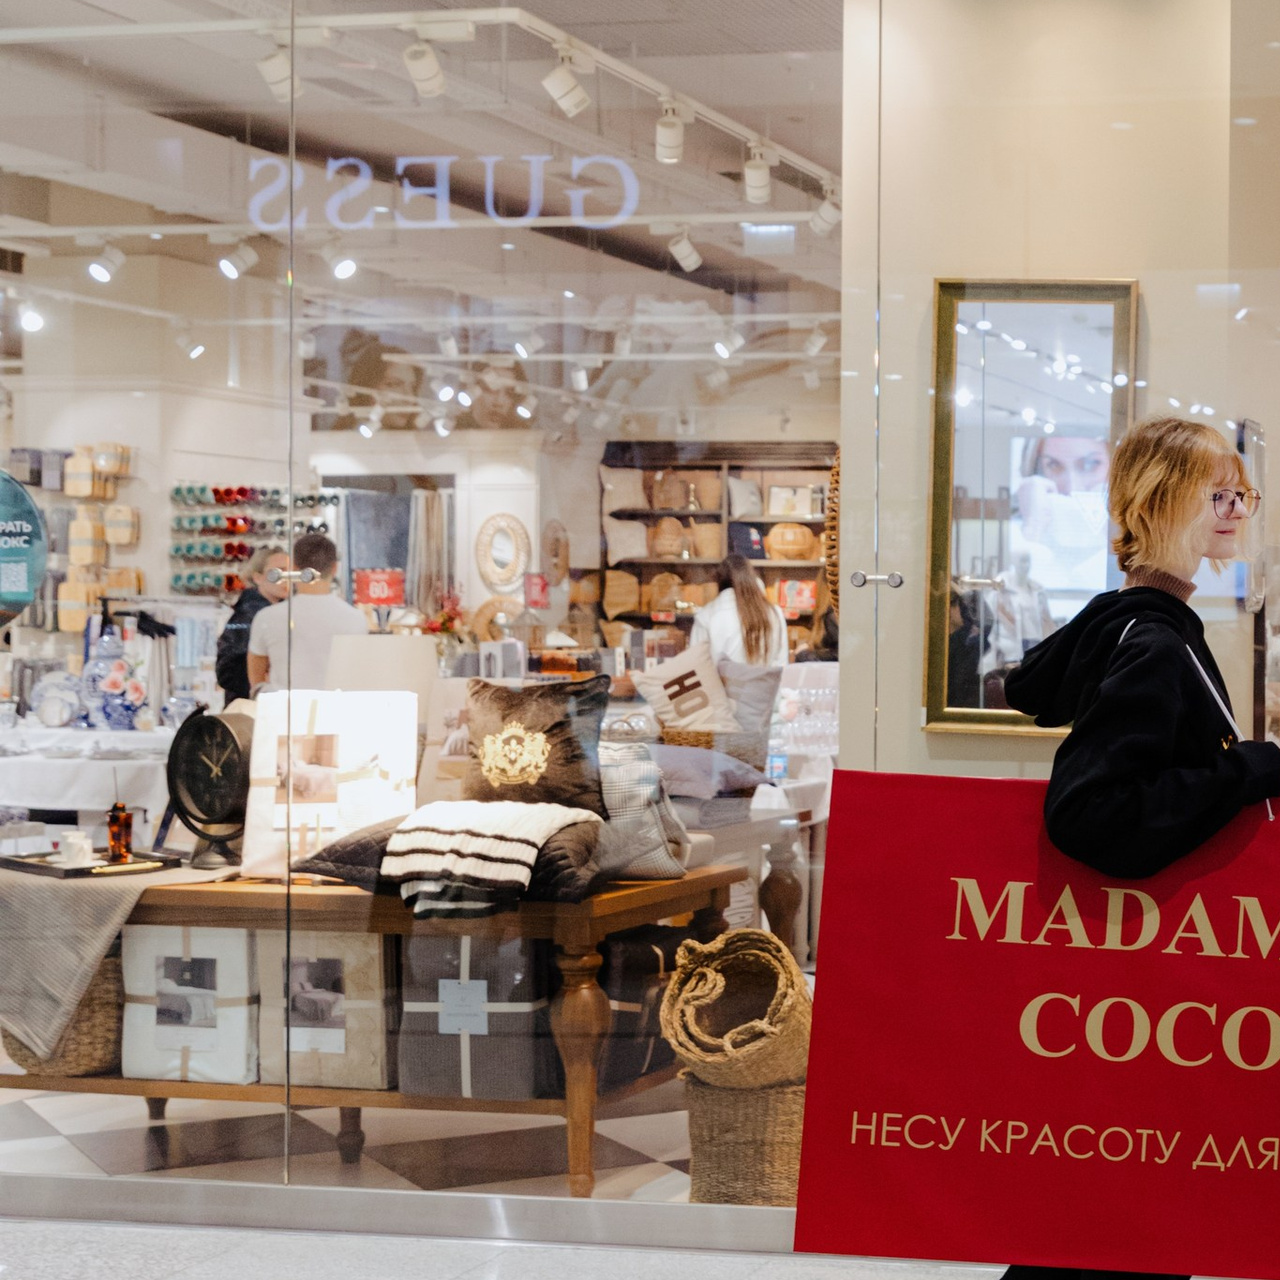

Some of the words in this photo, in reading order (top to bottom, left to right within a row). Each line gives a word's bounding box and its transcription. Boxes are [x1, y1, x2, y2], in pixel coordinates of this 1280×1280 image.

[0, 535, 30, 548] ОКС
[851, 1111, 966, 1151] НЕСУ
[980, 1120, 1181, 1164] КРАСОТУ
[1192, 1134, 1280, 1172] ДЛЯ
